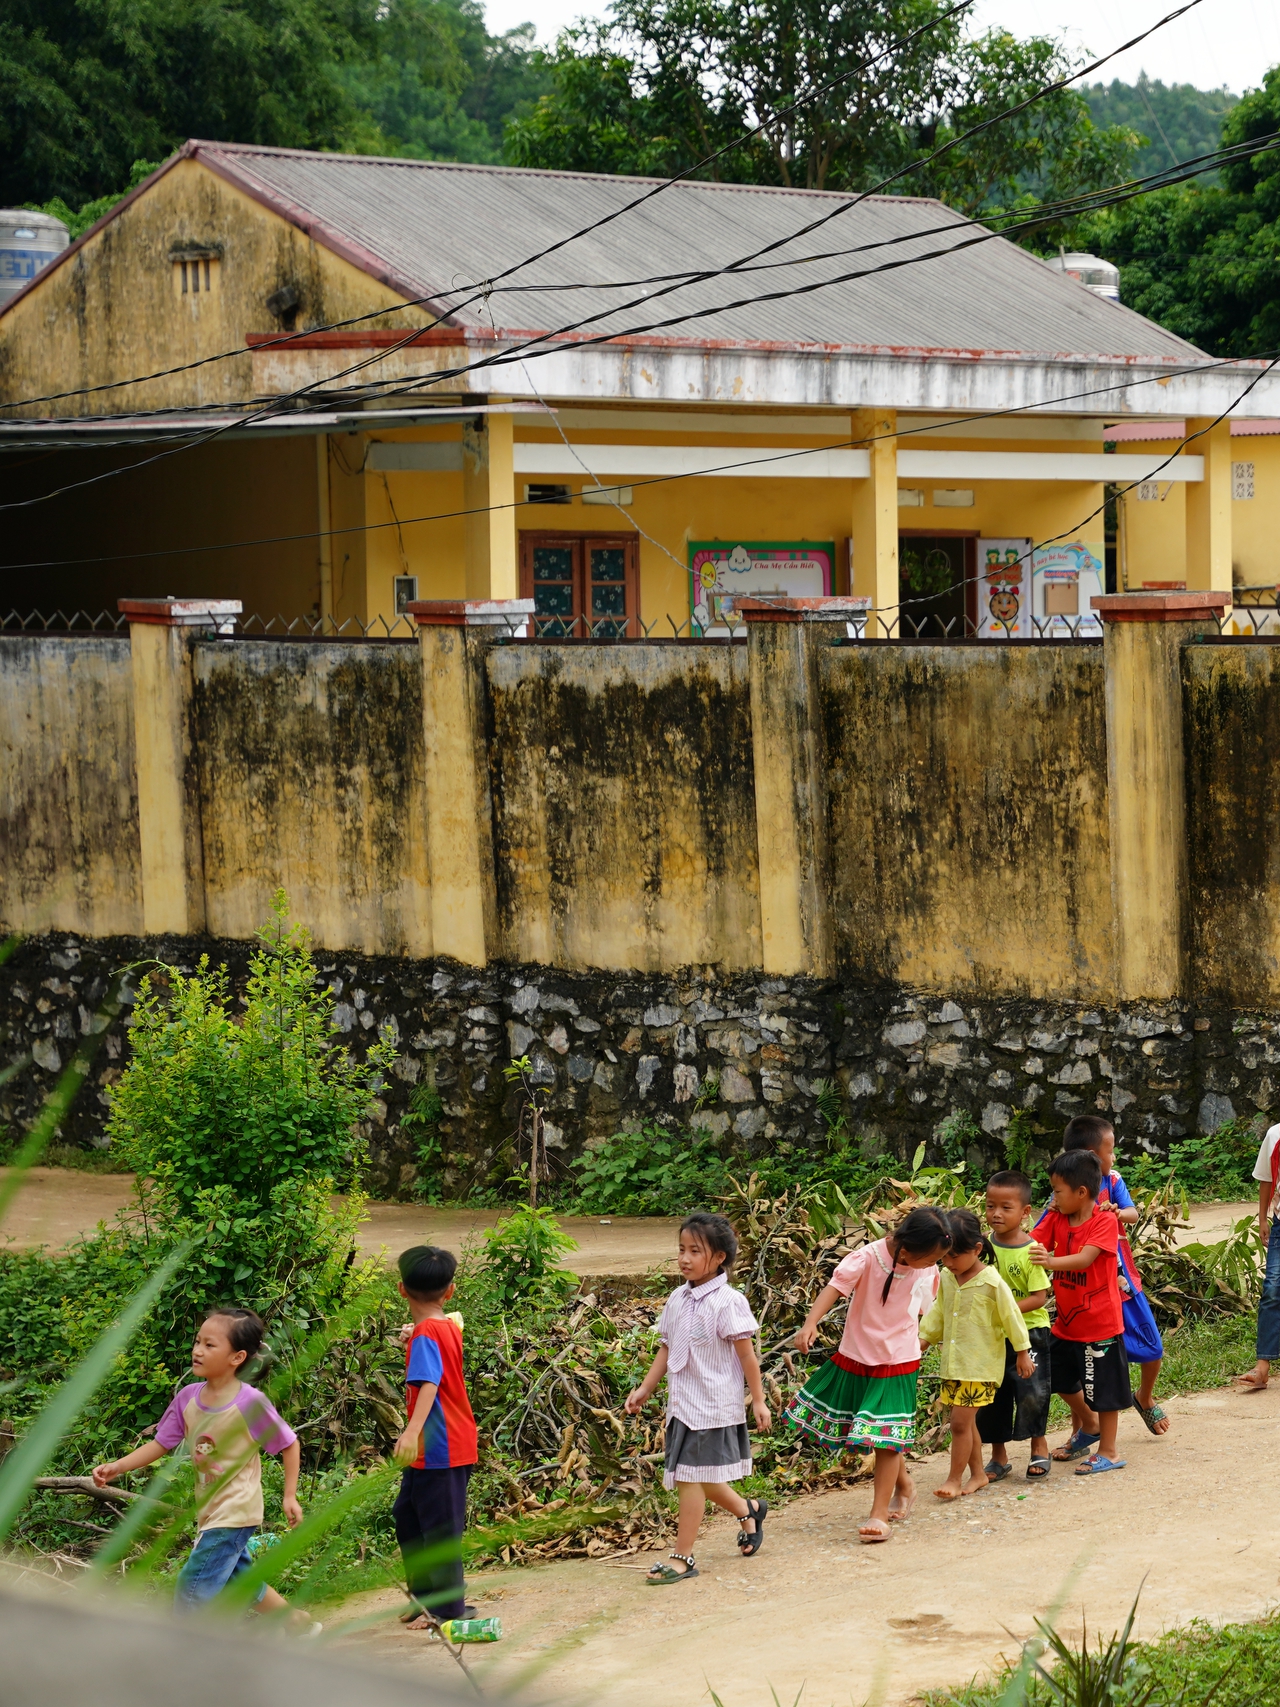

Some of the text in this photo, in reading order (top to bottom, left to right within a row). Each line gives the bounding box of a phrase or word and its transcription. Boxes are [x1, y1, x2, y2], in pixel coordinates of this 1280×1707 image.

[771, 562, 782, 570] Mẹ
[783, 561, 798, 569] Cần
[800, 561, 814, 569] Biết
[1084, 1348, 1095, 1402] BRONX BOY
